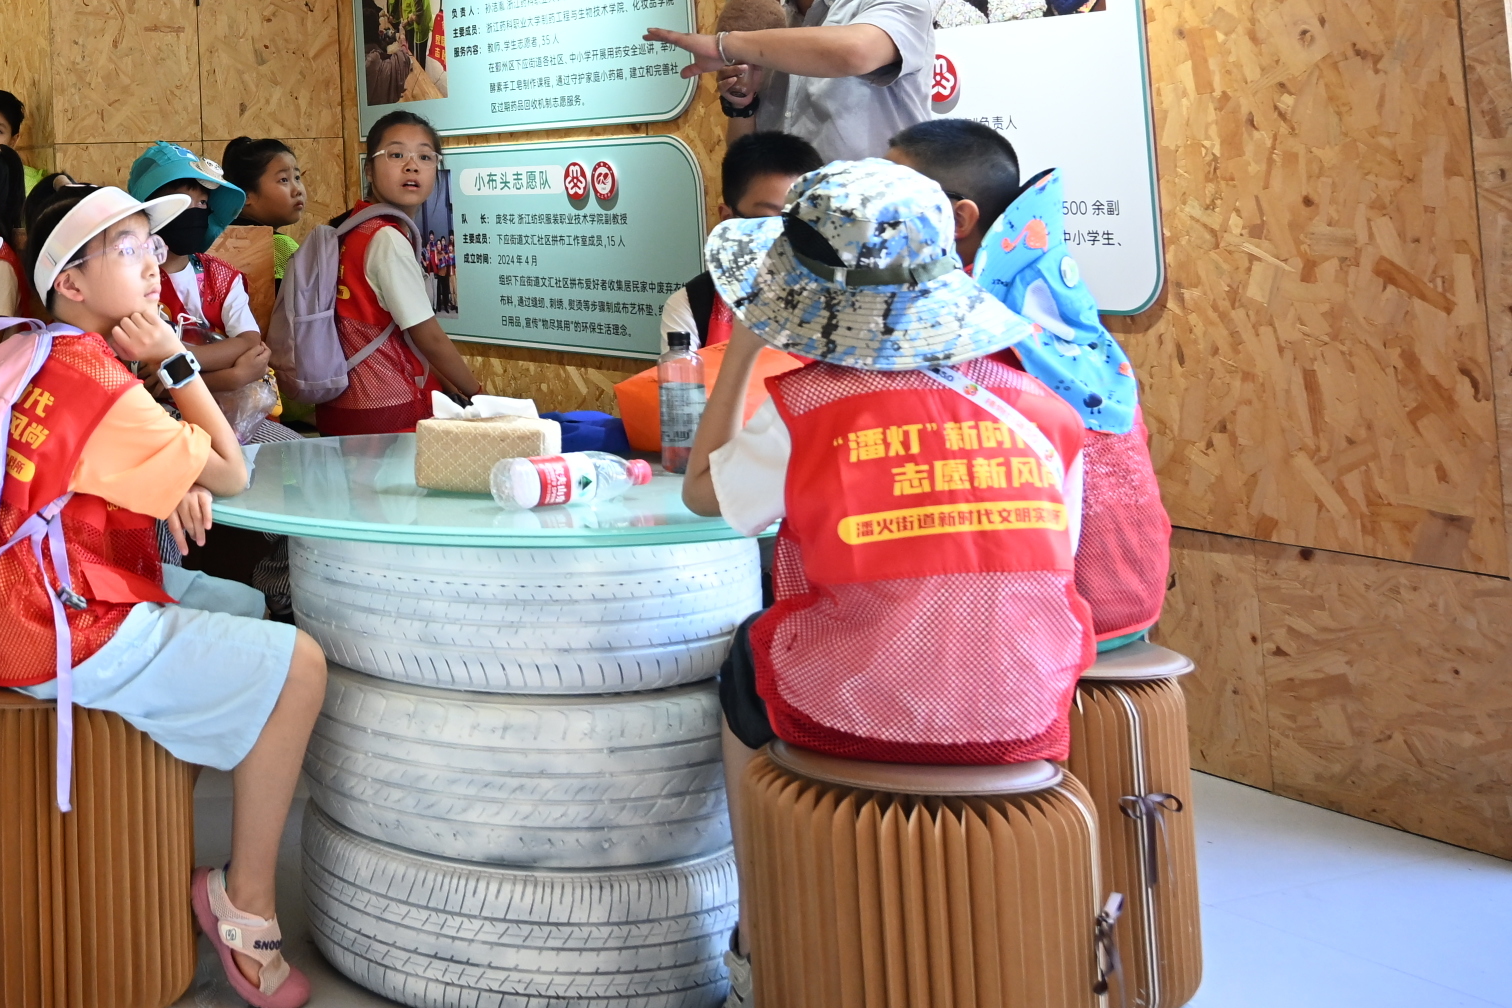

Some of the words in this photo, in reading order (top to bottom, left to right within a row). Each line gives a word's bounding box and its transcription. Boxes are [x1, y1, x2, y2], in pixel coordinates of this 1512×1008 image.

[474, 169, 552, 192] 小布头志愿队
[517, 212, 628, 226] 浙江纺织服装职业技术学院副教授
[463, 234, 491, 245] 主要成员：
[463, 254, 492, 265] 成立时间：
